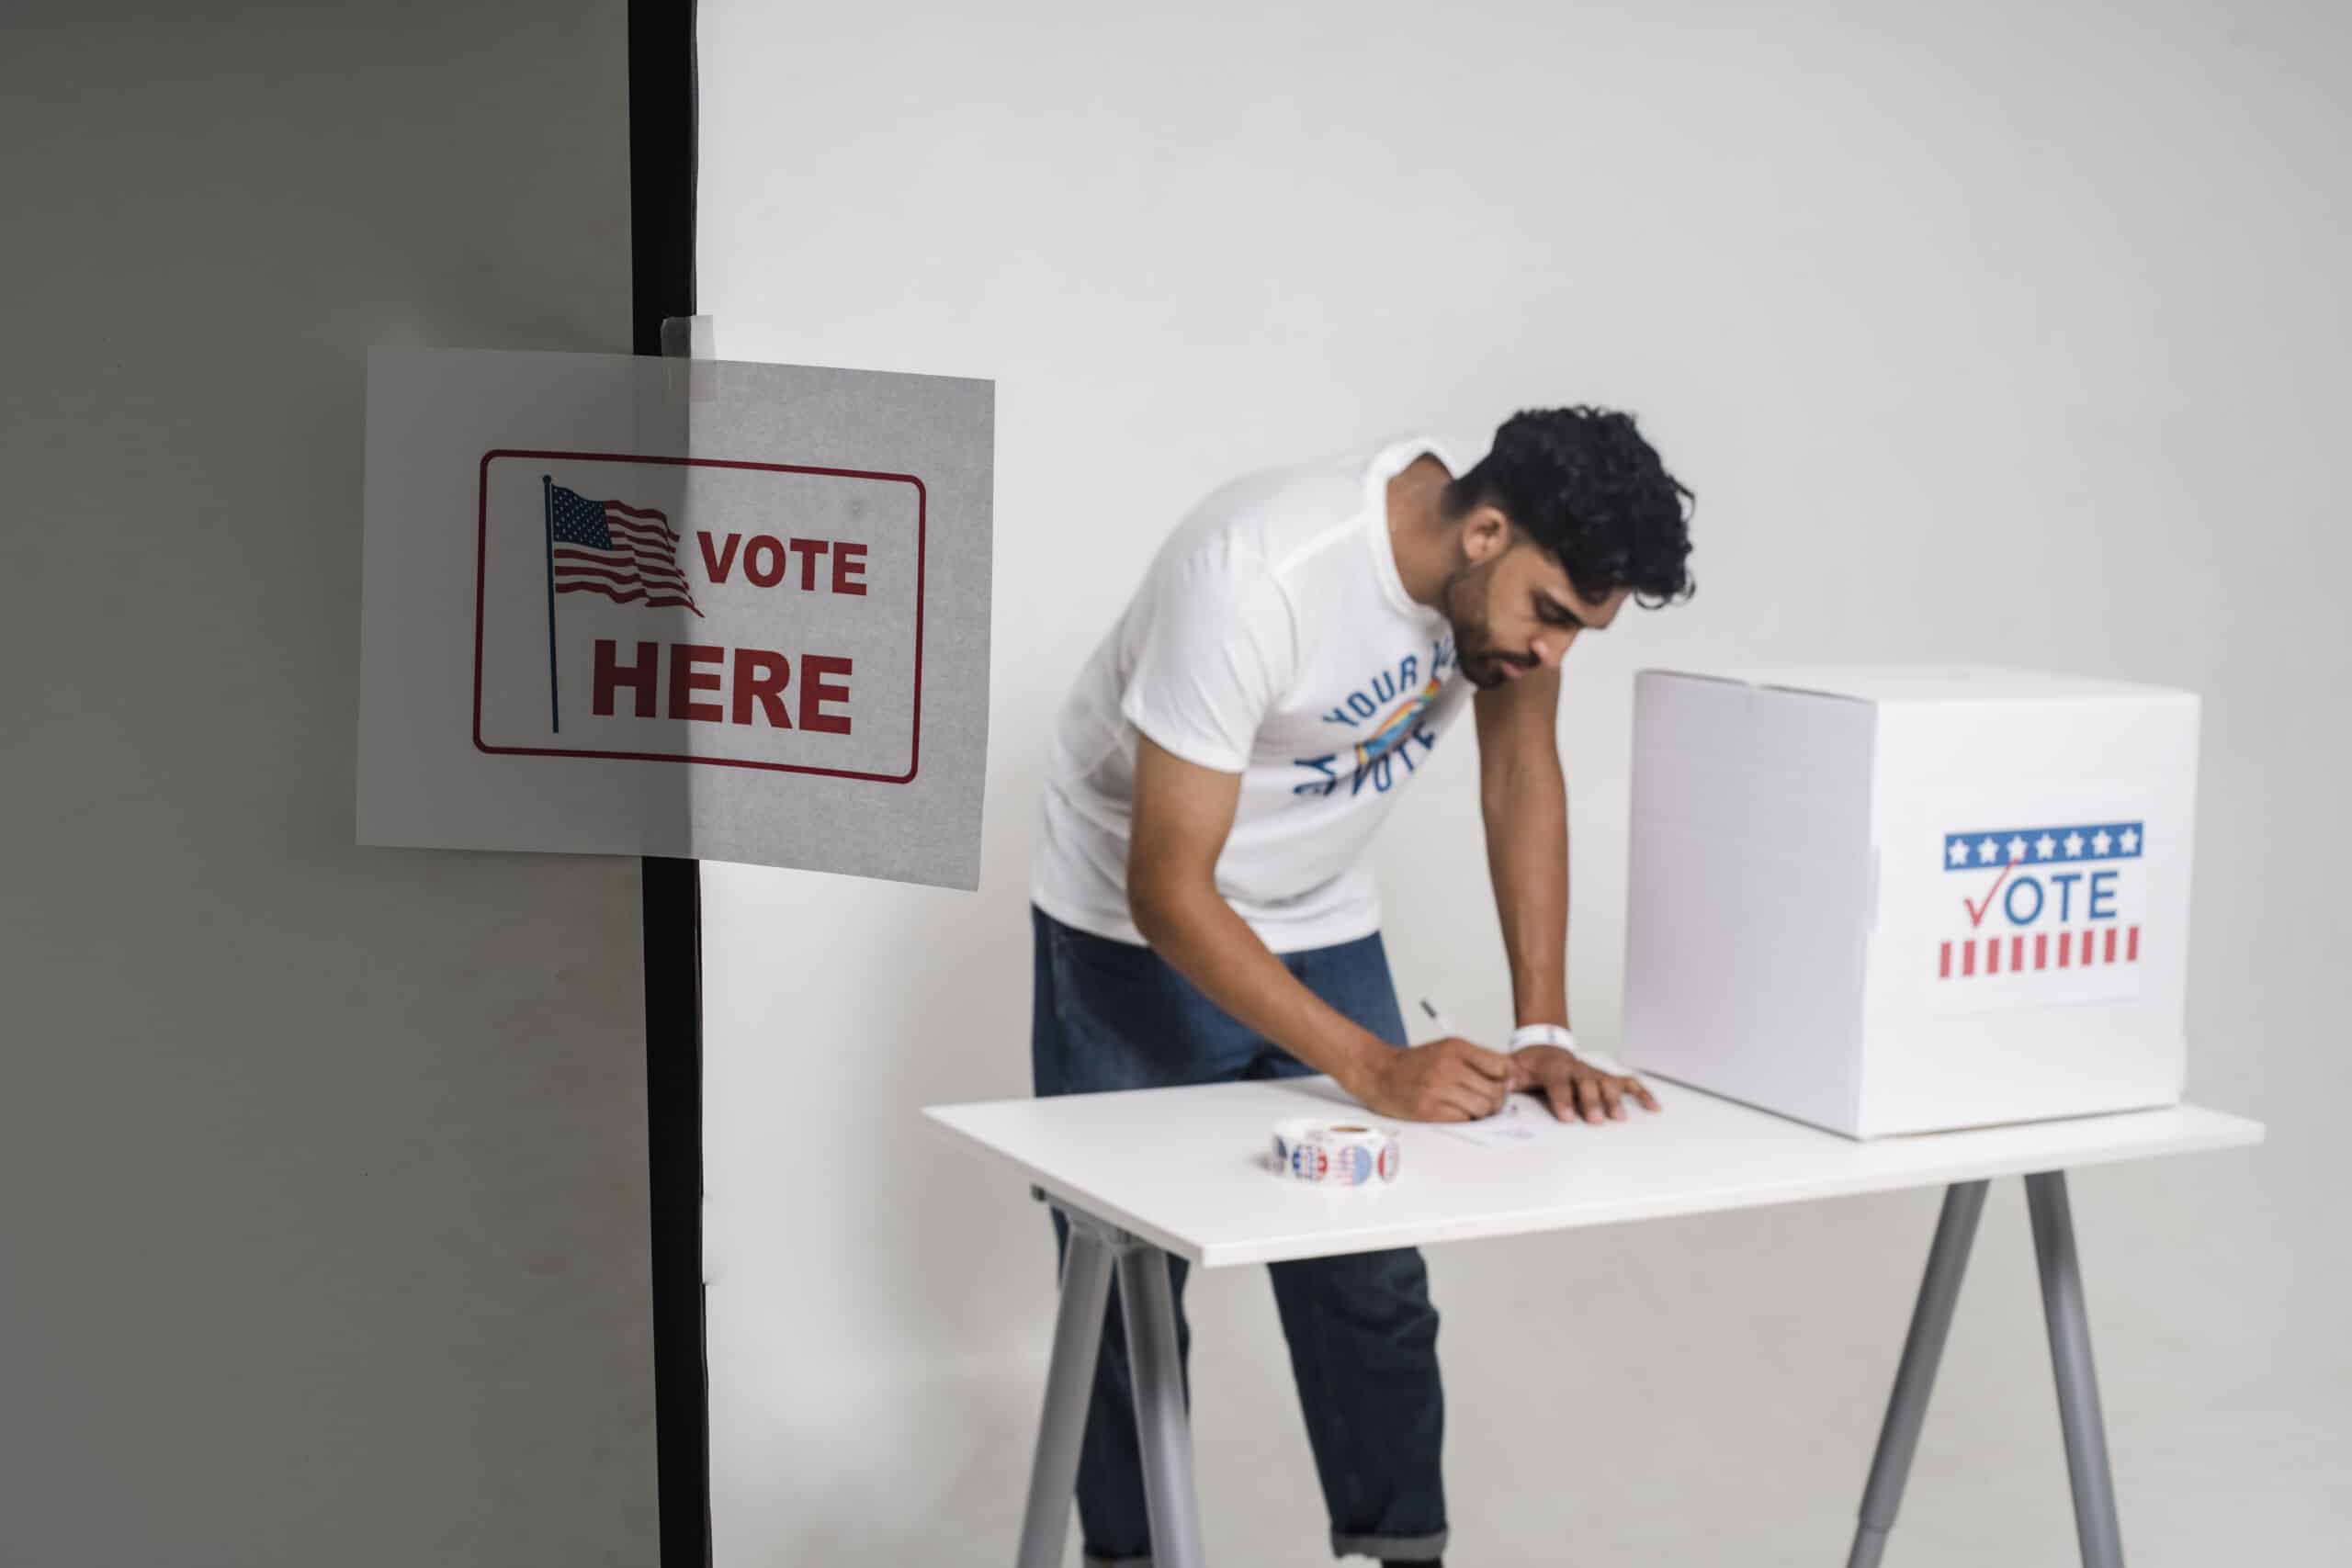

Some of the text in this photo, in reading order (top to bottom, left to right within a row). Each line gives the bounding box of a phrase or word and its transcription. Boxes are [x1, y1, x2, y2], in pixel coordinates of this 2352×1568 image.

[696, 531, 868, 596] VOTE
[593, 639, 854, 735] HERE
[1323, 655, 1417, 727] YOUR
